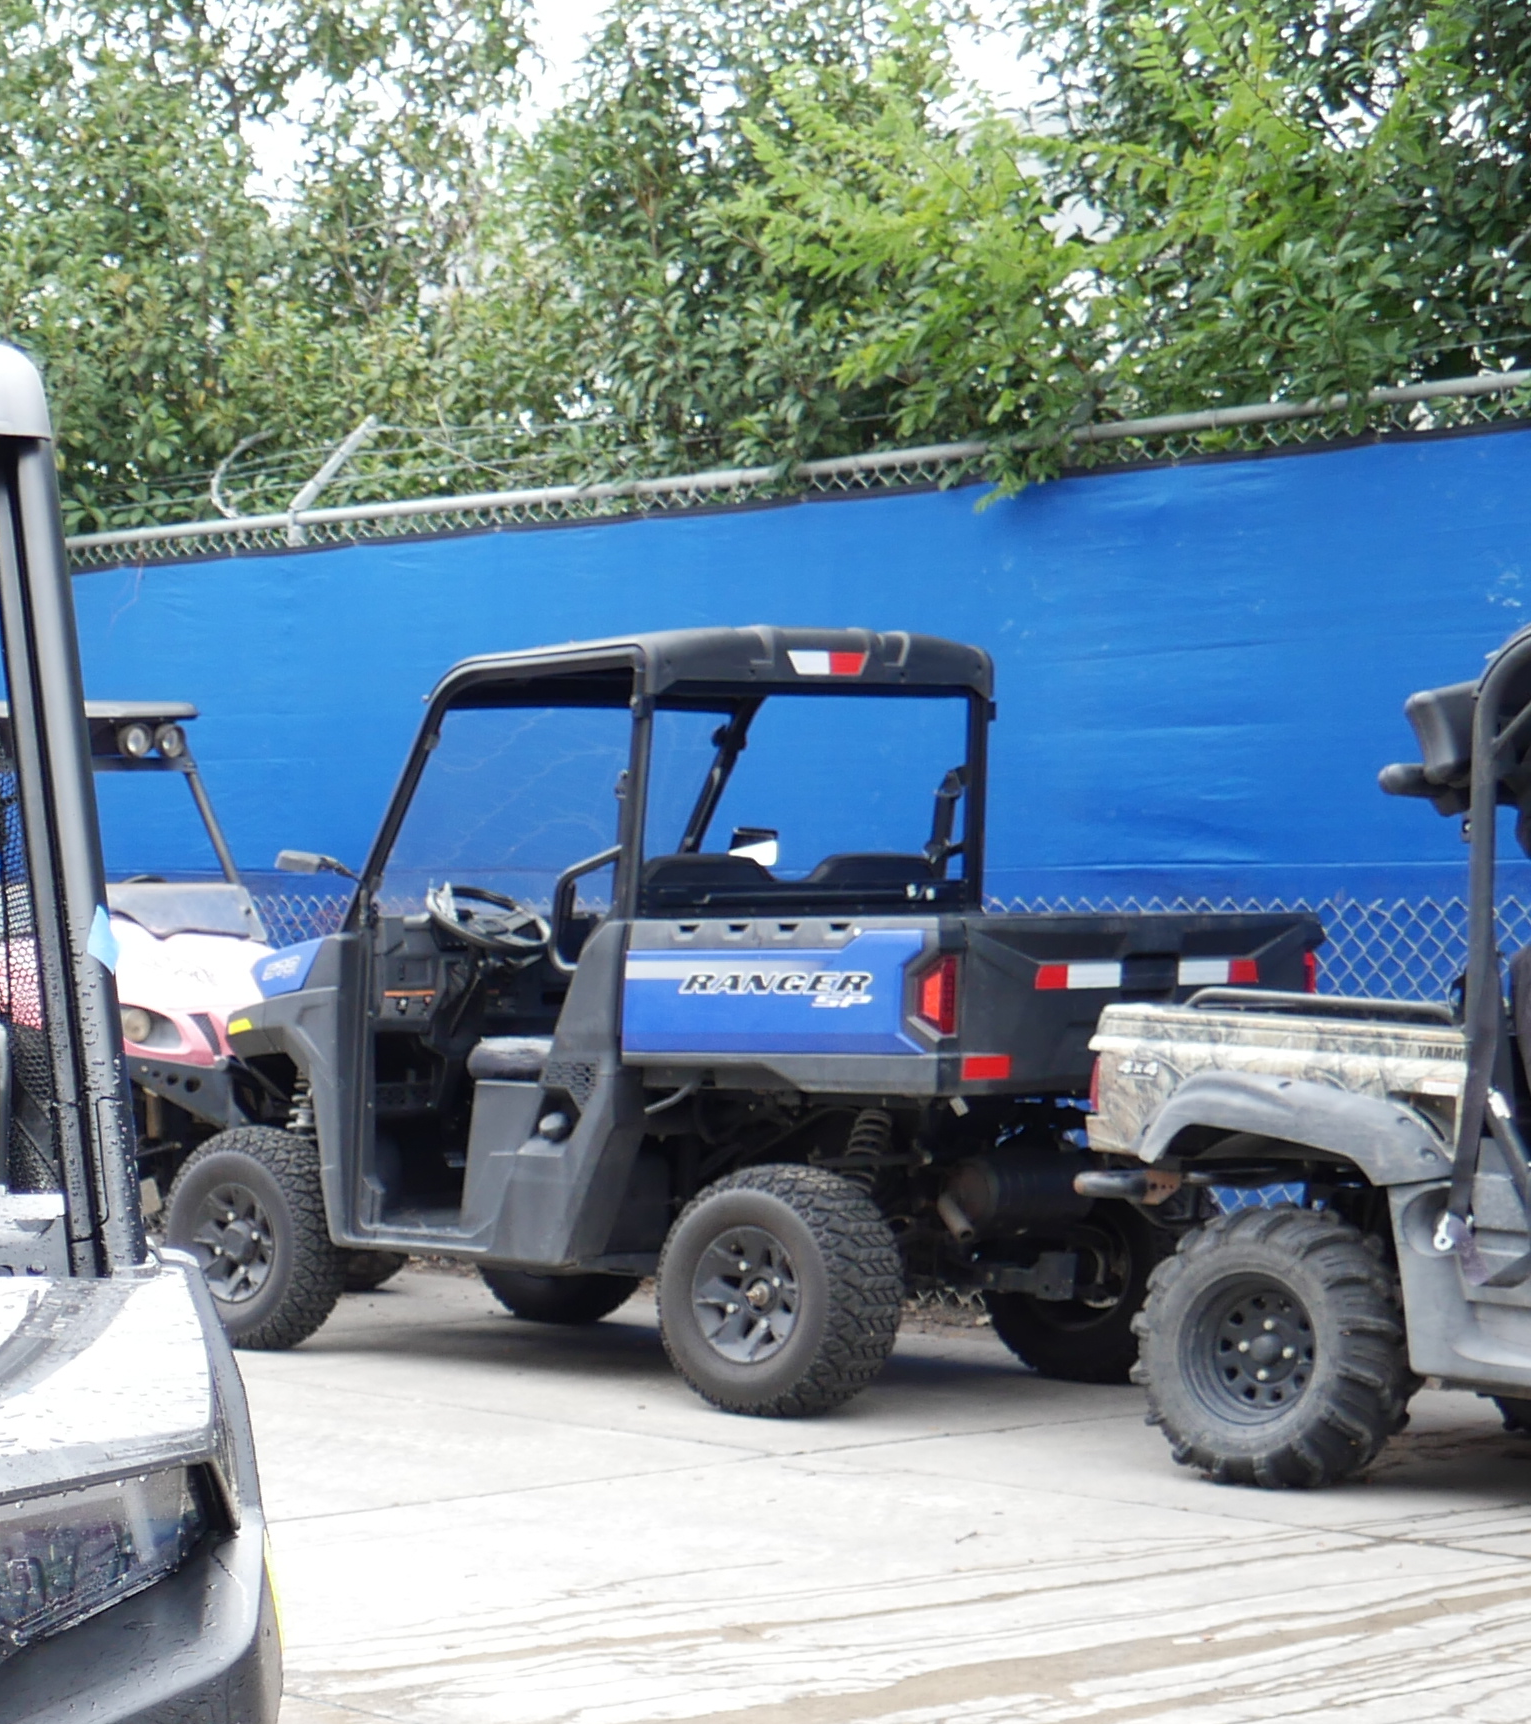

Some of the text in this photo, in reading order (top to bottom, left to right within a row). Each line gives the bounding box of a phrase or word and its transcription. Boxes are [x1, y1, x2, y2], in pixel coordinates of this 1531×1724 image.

[679, 971, 873, 996] RANGER
[811, 994, 873, 1008] SP
[1418, 1044, 1464, 1061] YAMAH
